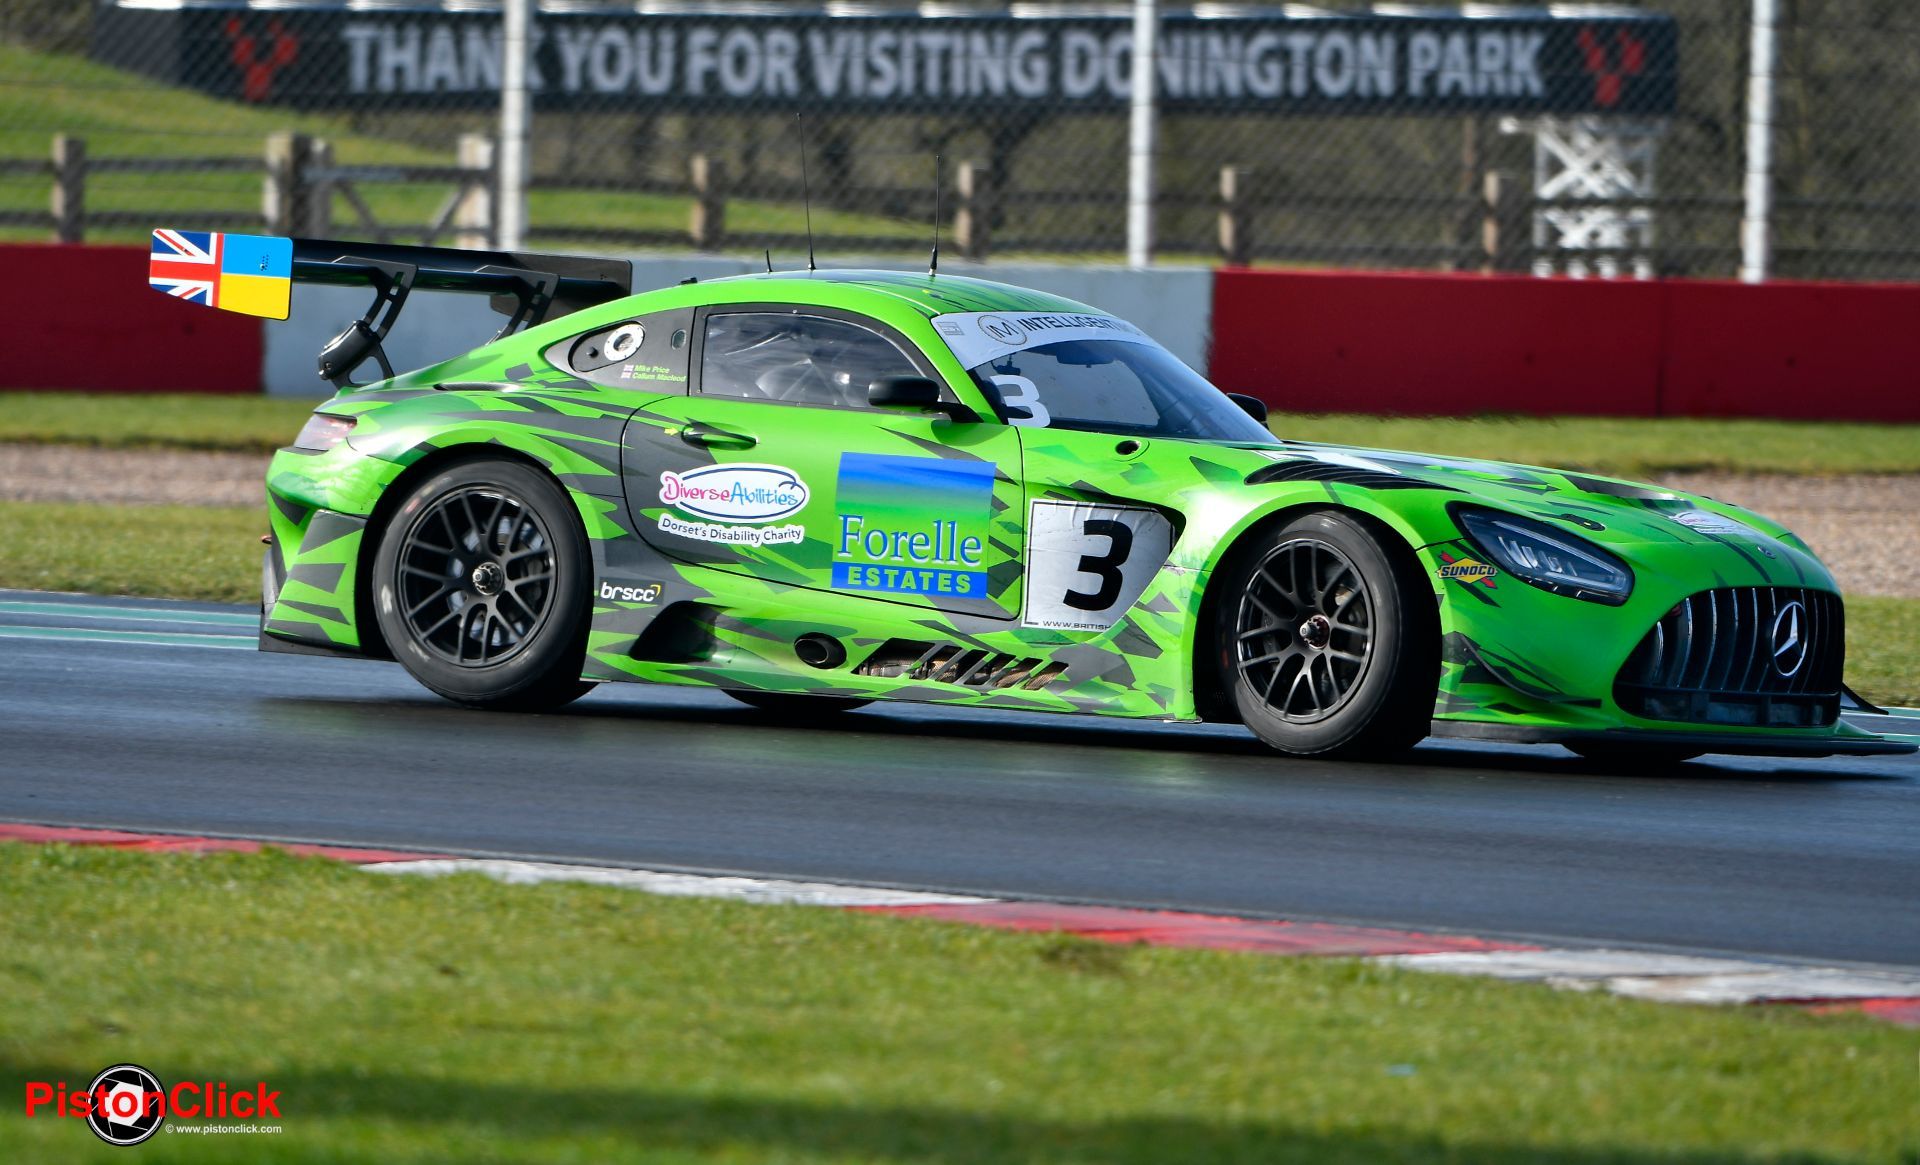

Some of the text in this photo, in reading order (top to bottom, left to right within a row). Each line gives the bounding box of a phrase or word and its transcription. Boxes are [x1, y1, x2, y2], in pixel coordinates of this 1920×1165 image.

[556, 27, 676, 93] YOU
[685, 29, 799, 97] FOR
[808, 29, 1050, 98] VISITING
[1061, 30, 1396, 99] DONINGTON
[1407, 32, 1547, 98] PARK
[990, 374, 1050, 427] 3
[664, 476, 799, 506] DiverseAbilities
[662, 518, 801, 543] Dorset's Disability Charity
[837, 514, 983, 567] Forelle
[848, 566, 971, 594] ESTATES
[1063, 519, 1133, 611] 3
[1441, 565, 1495, 577] SUNOCO
[600, 582, 655, 602] brscc
